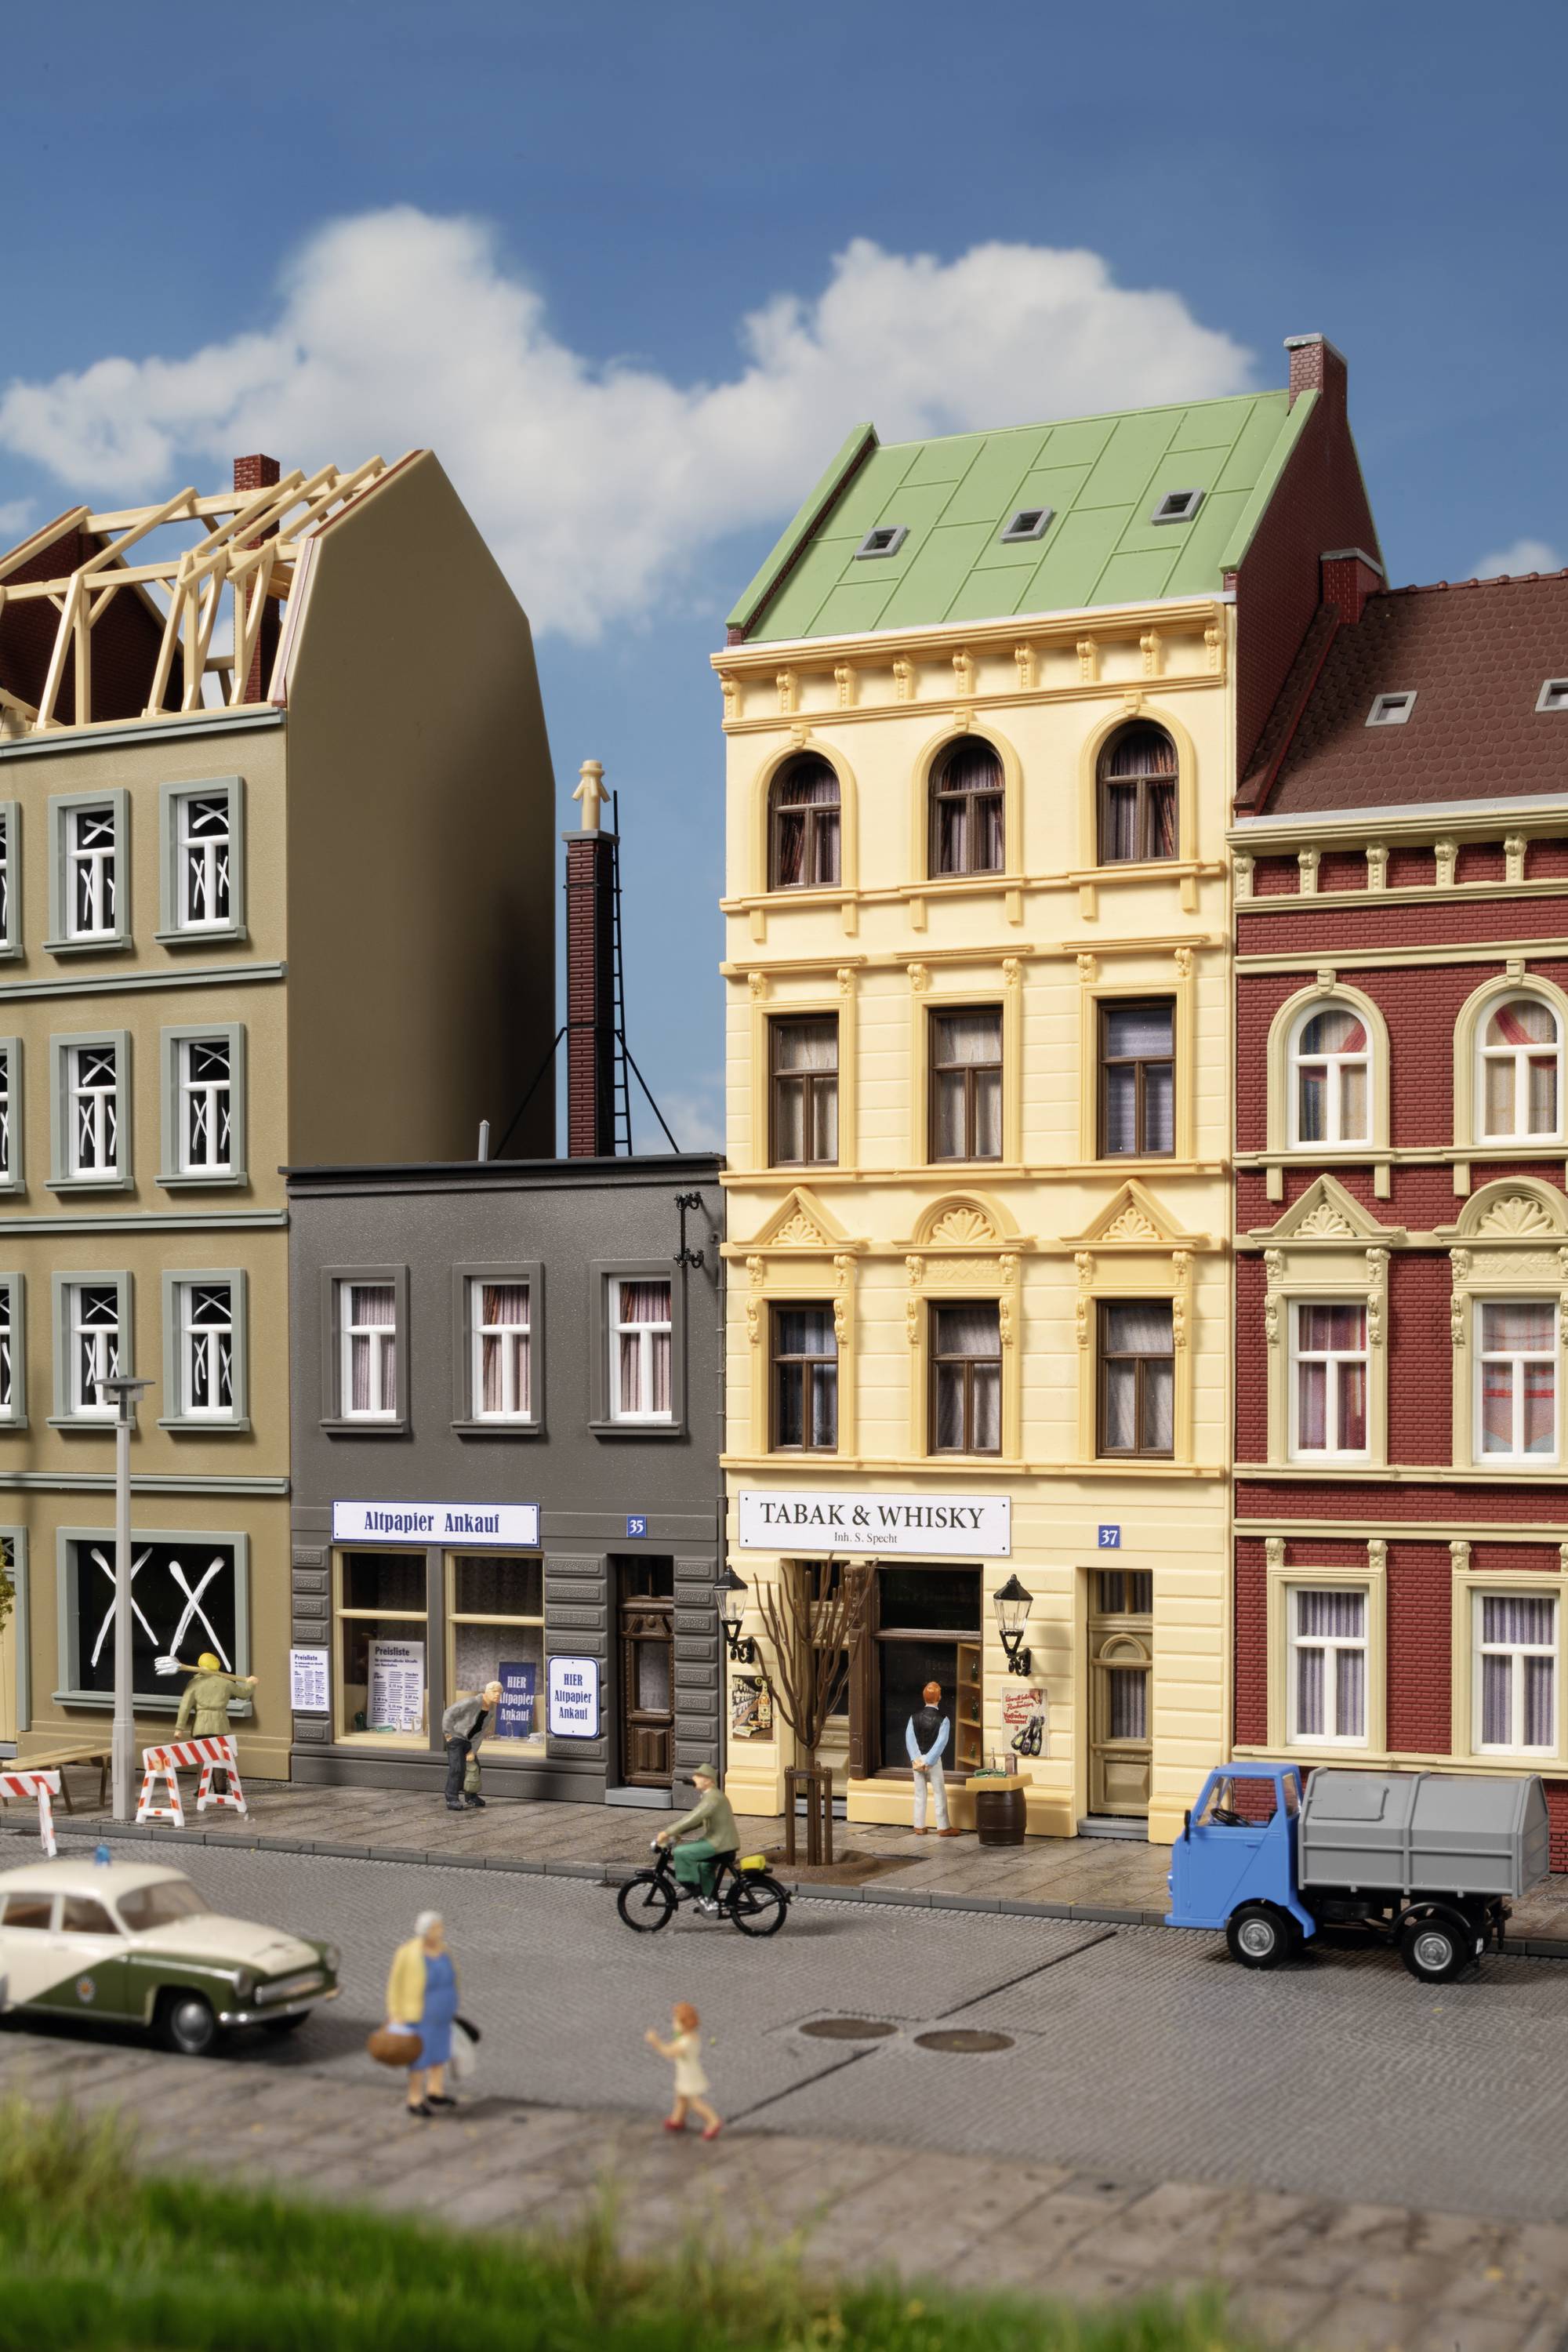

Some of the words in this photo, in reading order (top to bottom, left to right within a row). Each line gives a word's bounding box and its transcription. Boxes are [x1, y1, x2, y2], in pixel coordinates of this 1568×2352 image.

[364, 1511, 434, 1534] Altpapier
[445, 1513, 500, 1534] Ankauf
[760, 1502, 846, 1526] TABAK
[852, 1504, 871, 1526] &
[877, 1505, 985, 1530] WHISKY
[629, 1519, 644, 1534] 35
[834, 1531, 852, 1542] Inh.
[855, 1533, 864, 1543] S.
[866, 1534, 898, 1545] Specht
[1101, 1530, 1118, 1545] 37
[375, 1646, 410, 1656] Preisliste
[506, 1675, 527, 1689] HIER
[564, 1673, 583, 1686] HIER
[554, 1690, 592, 1704] Altpapier
[500, 1708, 529, 1721] Ankauf
[558, 1707, 588, 1720] Ankauf
